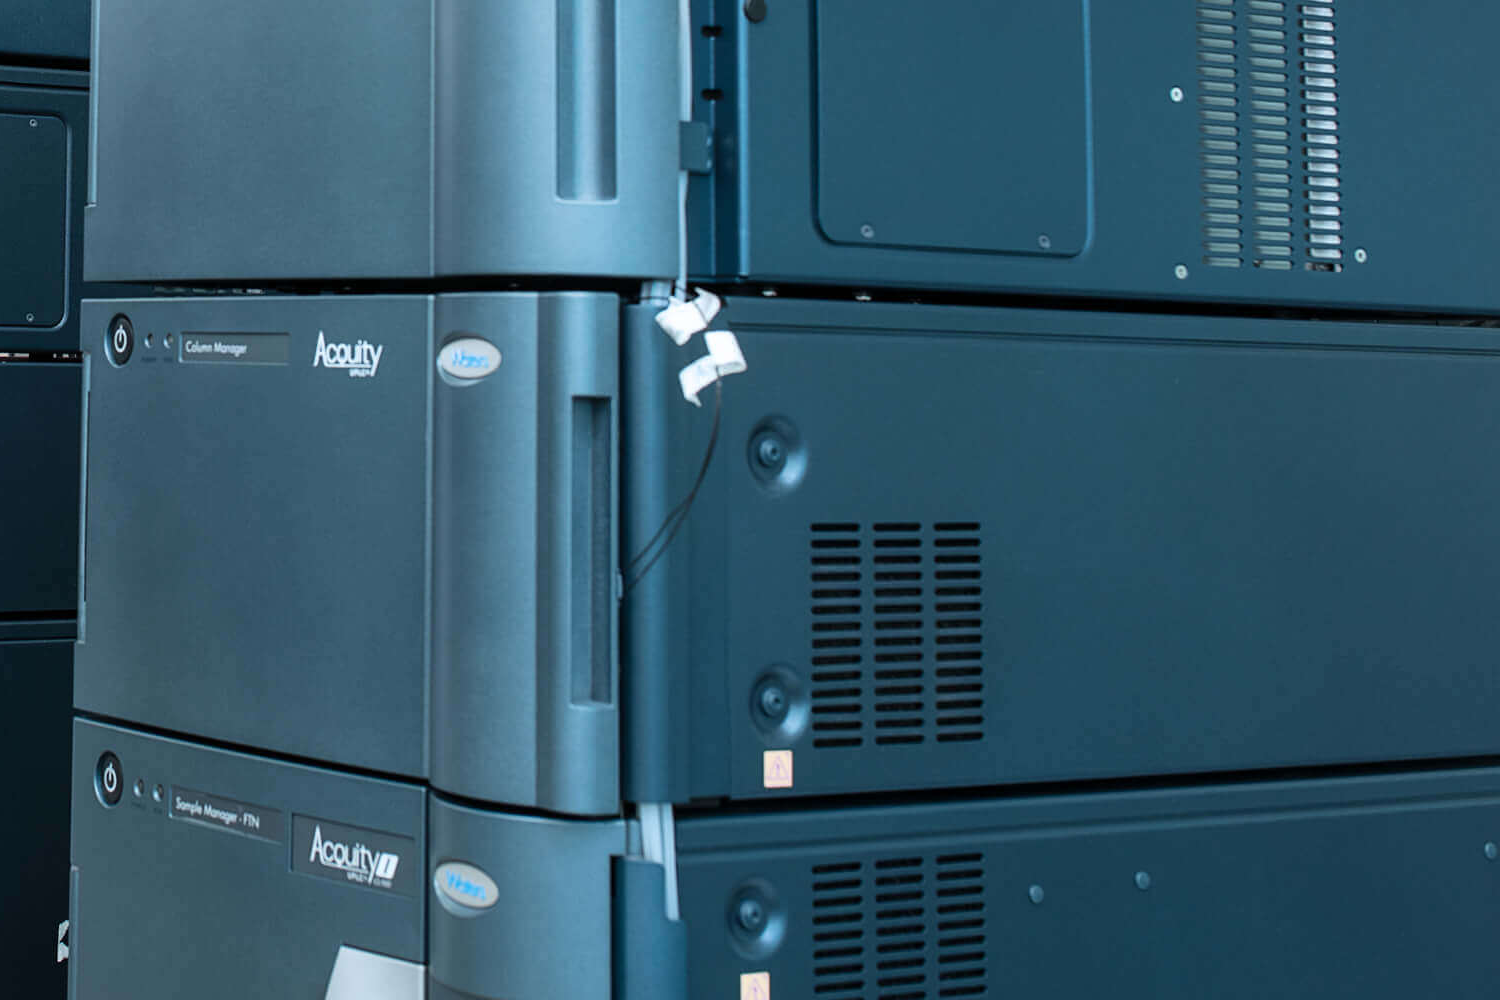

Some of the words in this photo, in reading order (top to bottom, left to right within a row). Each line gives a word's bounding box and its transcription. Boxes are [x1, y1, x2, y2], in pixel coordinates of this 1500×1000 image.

[185, 341, 213, 354] Column
[214, 341, 248, 358] Manager
[313, 330, 383, 376] Acquity
[175, 796, 202, 815] Sample
[203, 803, 238, 824] Manager
[243, 812, 260, 829] FTN
[310, 824, 380, 884] Acquity
